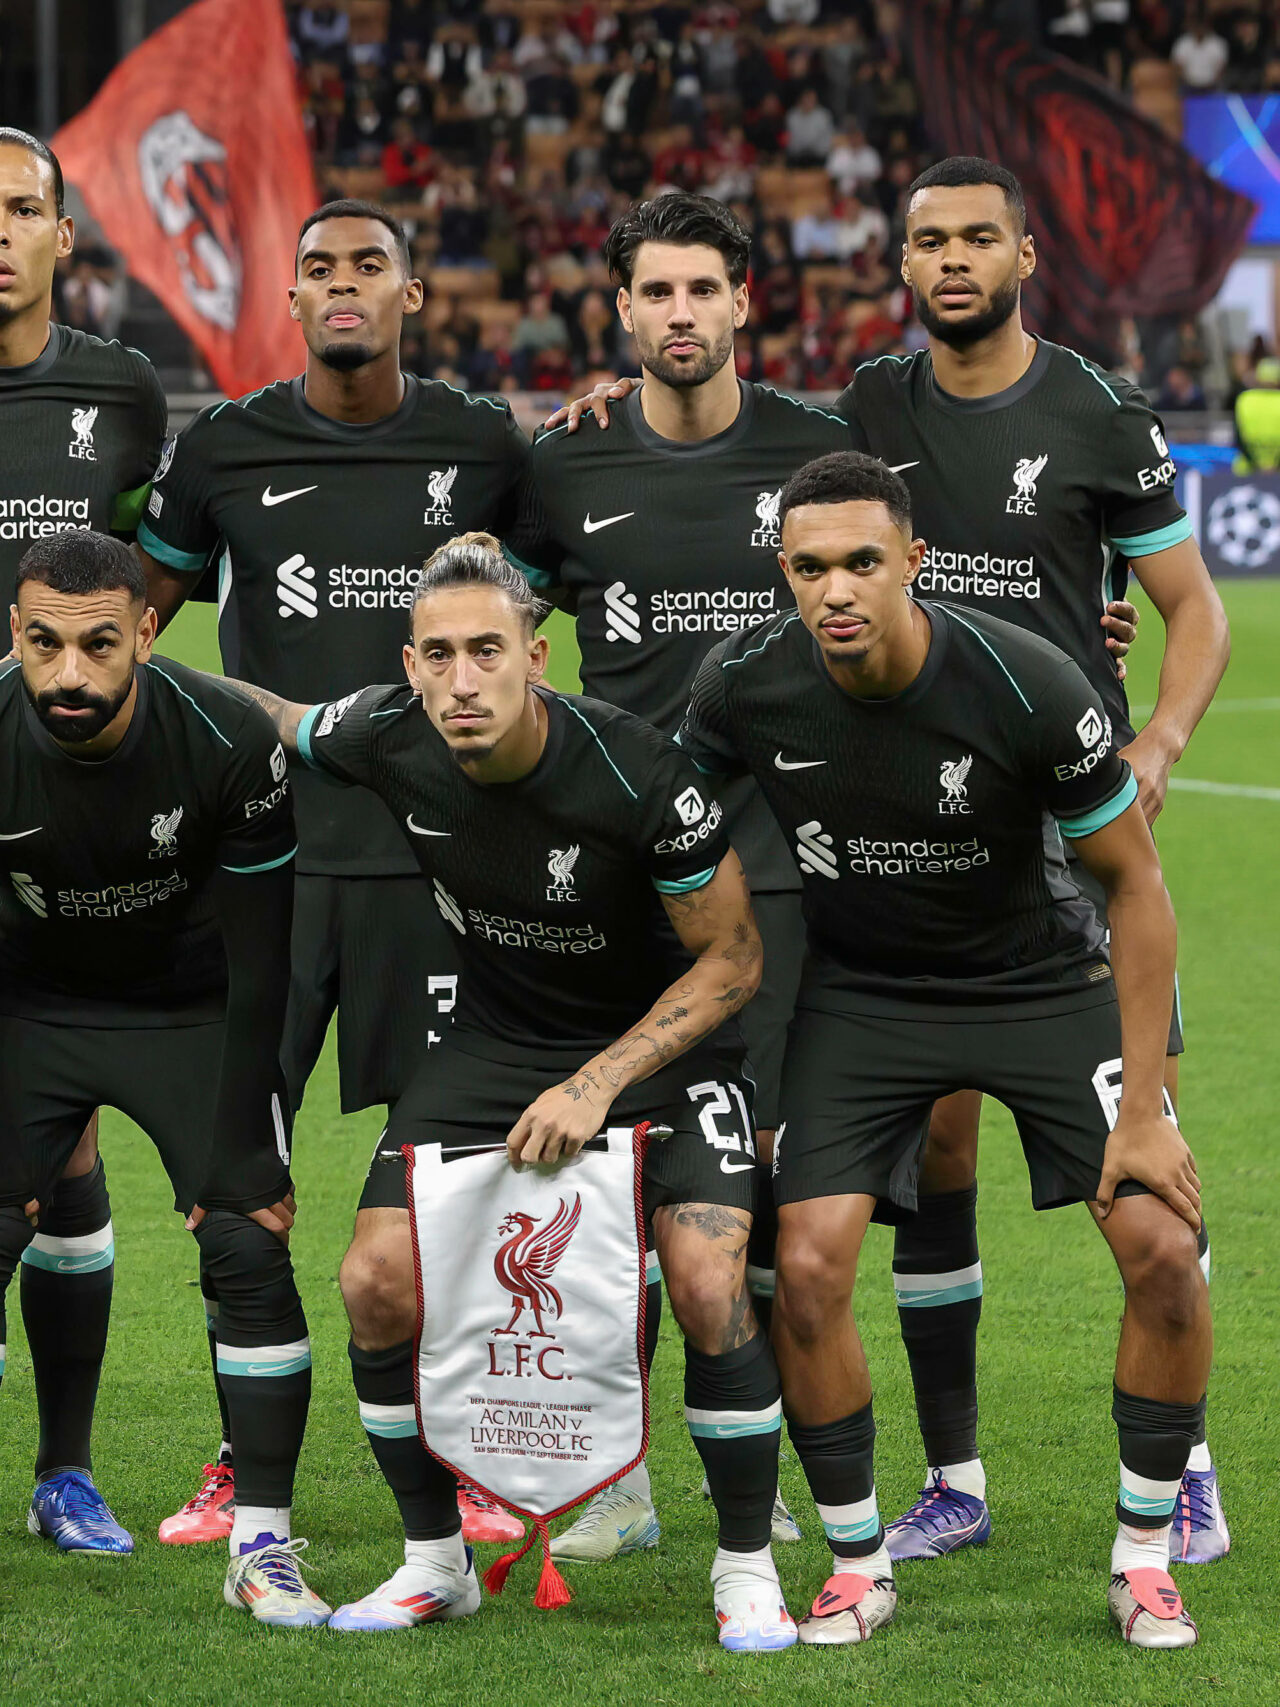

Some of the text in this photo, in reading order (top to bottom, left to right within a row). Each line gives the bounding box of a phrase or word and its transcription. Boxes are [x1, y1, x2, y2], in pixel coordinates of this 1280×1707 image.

[920, 546, 1033, 577] standard
[328, 564, 423, 586] standa
[918, 569, 1041, 600] chartered
[328, 587, 413, 609] charte
[650, 587, 775, 611] standard
[938, 803, 974, 815] L.F.C.
[847, 836, 979, 858] standard
[850, 848, 990, 876] chartered
[58, 868, 180, 904] standard
[59, 877, 188, 917] chartered
[546, 889, 581, 902] L.F.C.
[468, 909, 593, 938] standard
[474, 925, 607, 954] chartered
[686, 1080, 756, 1160] 21
[487, 1342, 573, 1381] L.F.C.
[487, 1398, 520, 1407] CHAMPIONS
[520, 1401, 542, 1410] LEAGUE
[546, 1403, 569, 1411] LEAGUE
[480, 1408, 504, 1425] AC
[508, 1410, 566, 1430] MILAN
[471, 1427, 593, 1451] LIVERPOOL FC
[501, 1448, 526, 1456] STADIUM
[537, 1451, 571, 1459] SEPTEMBER
